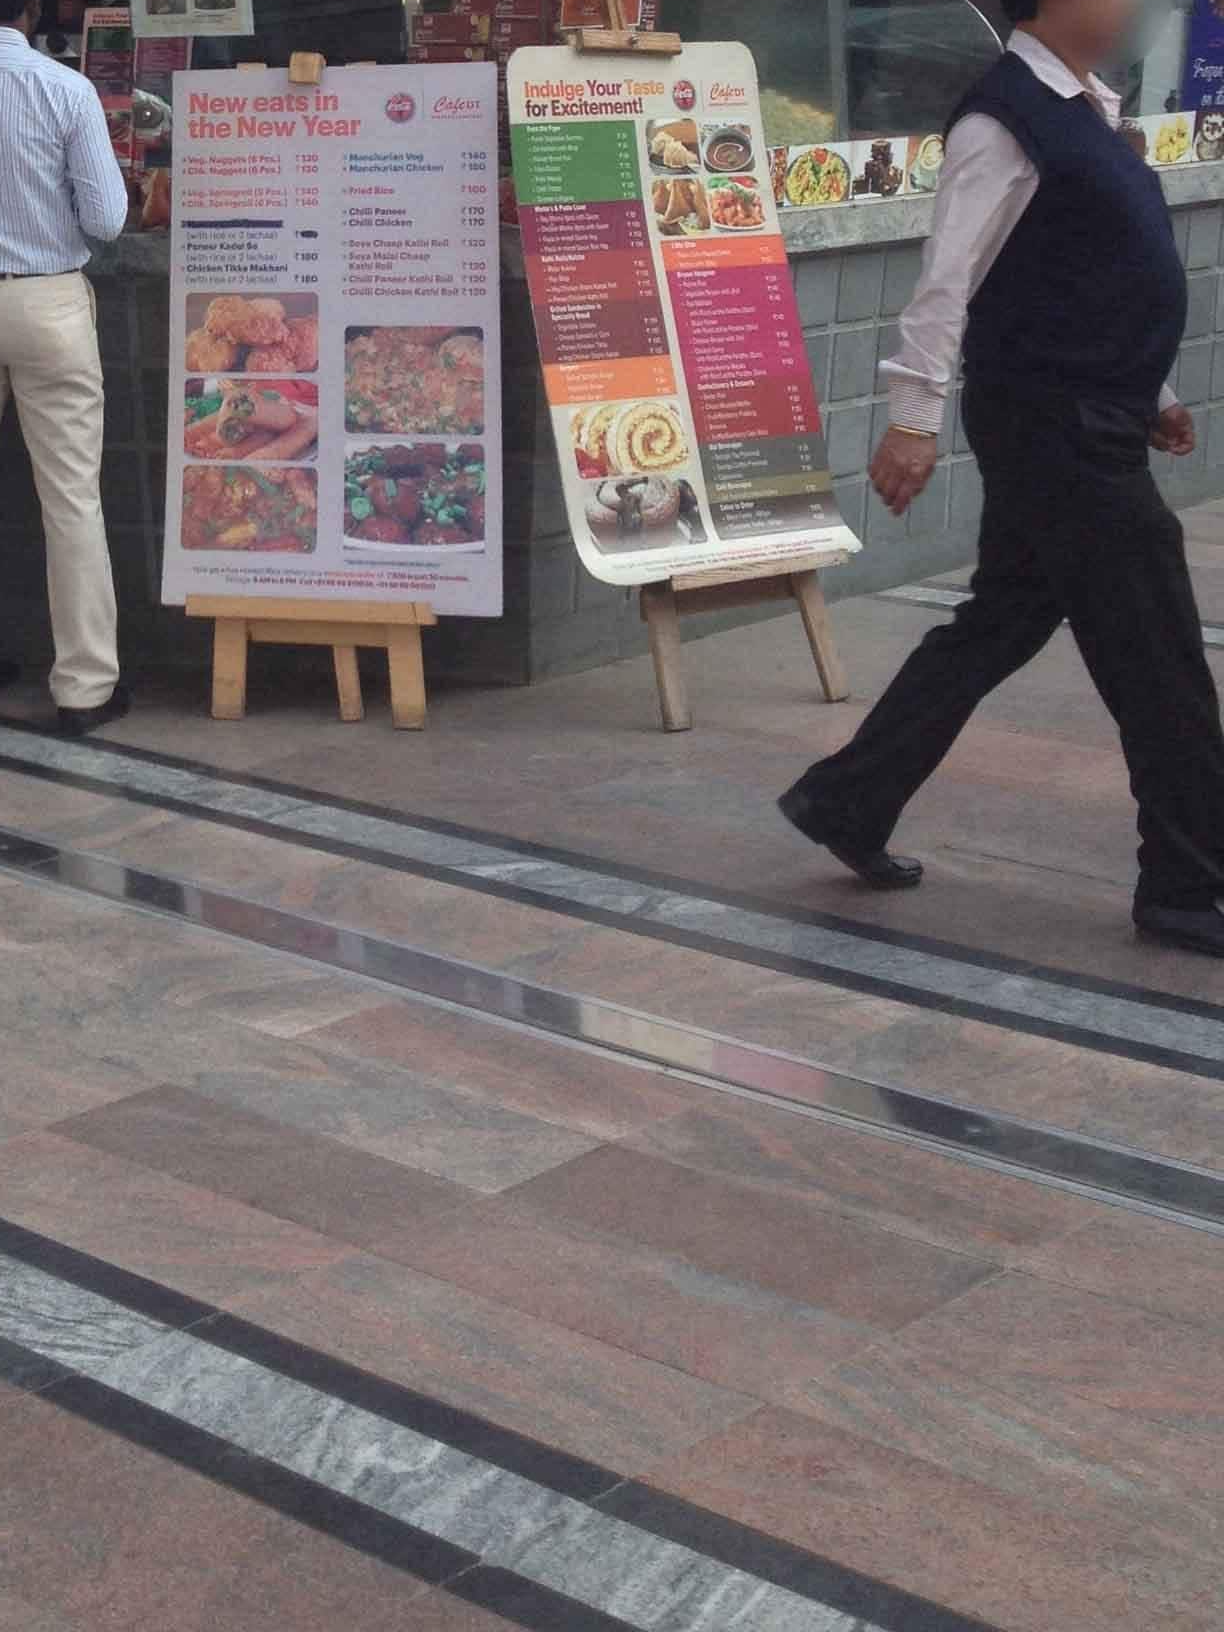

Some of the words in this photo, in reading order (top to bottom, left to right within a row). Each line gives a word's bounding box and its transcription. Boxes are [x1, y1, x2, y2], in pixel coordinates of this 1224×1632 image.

[524, 79, 584, 100] Indulge
[586, 79, 622, 96] Your
[624, 78, 664, 96] Taste
[188, 92, 249, 114] New
[252, 93, 309, 113] eats
[314, 89, 339, 112] in
[525, 99, 549, 117] for
[551, 97, 643, 116] Excitement!
[187, 116, 232, 139] the
[237, 116, 297, 138] New
[301, 114, 362, 137] Year
[406, 164, 444, 173] Chicken
[349, 186, 372, 195] Fried
[374, 186, 395, 195] Rice
[349, 207, 373, 216] Chilli
[375, 207, 406, 216] Paneer
[349, 218, 373, 228] Chilli
[375, 218, 413, 228] Chicken
[431, 239, 449, 248] Roll
[187, 264, 223, 273] Chicken
[225, 264, 248, 273] Tikka
[250, 264, 288, 273] Makhani
[375, 262, 392, 270] Roll
[349, 288, 373, 297] Chilli
[375, 288, 412, 297] Chicken
